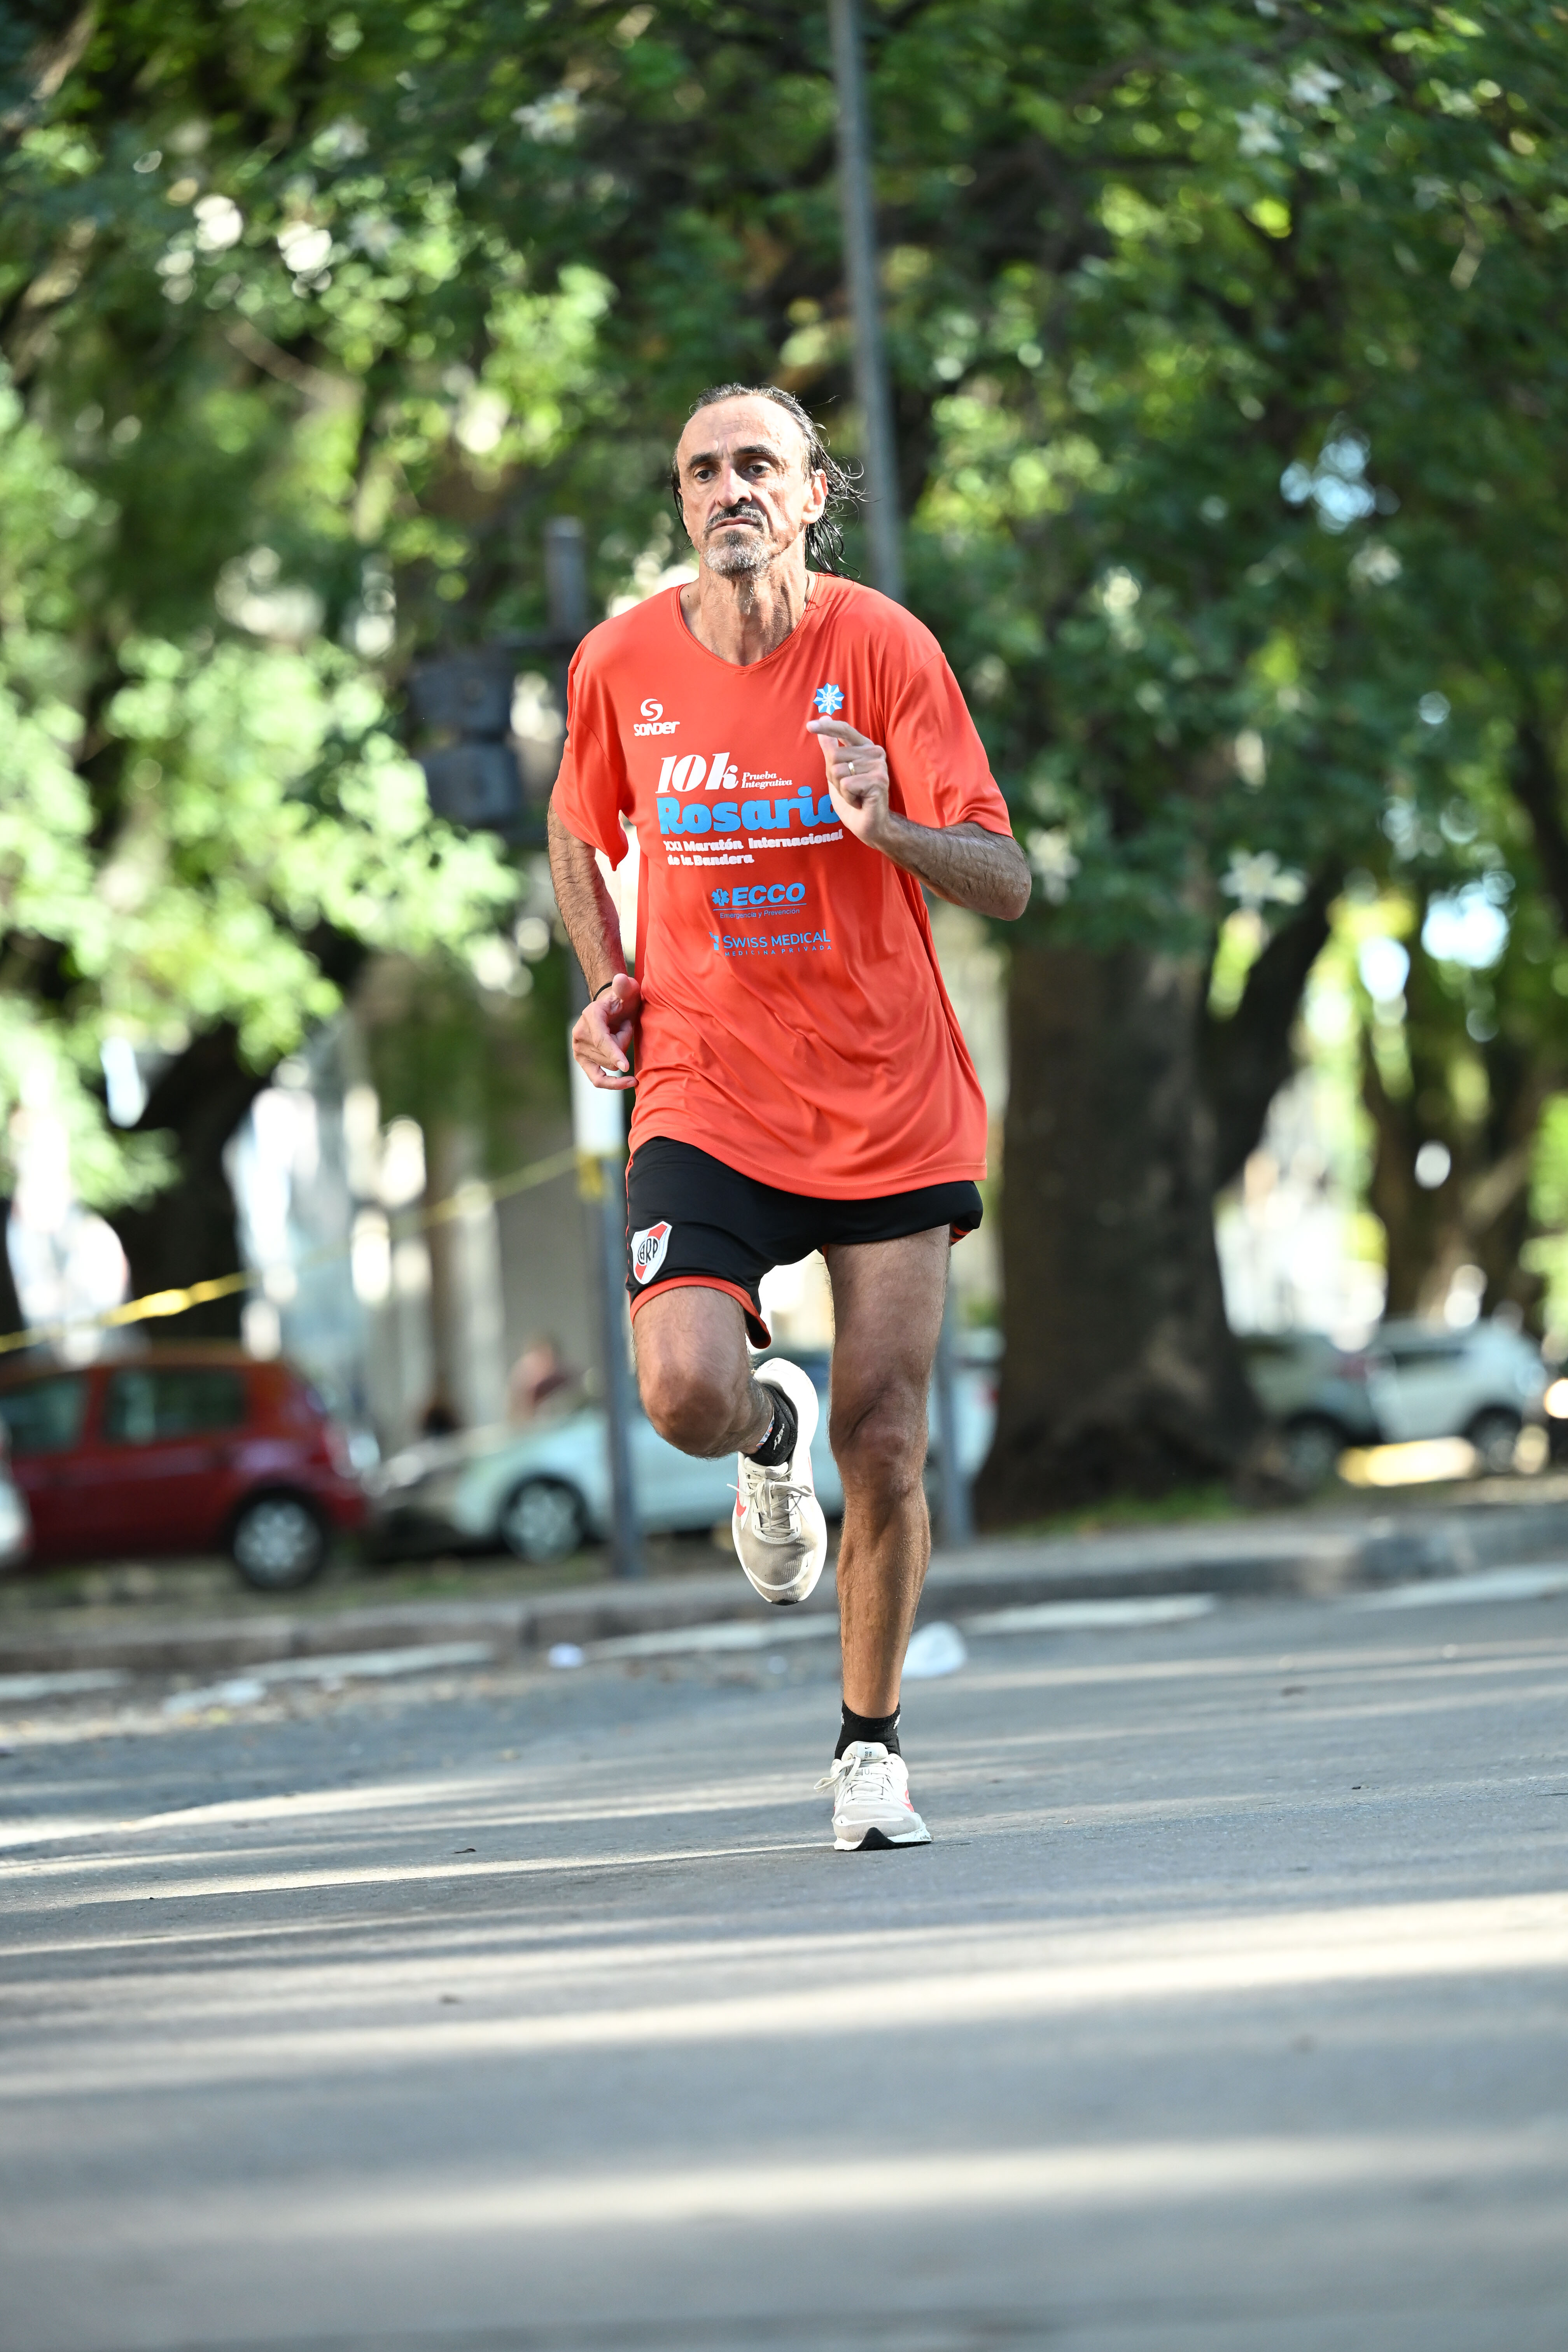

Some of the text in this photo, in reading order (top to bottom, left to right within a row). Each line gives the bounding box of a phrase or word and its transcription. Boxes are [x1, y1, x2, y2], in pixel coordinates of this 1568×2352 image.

[655, 752, 738, 793] 10k
[742, 771, 777, 780] Prueba
[741, 778, 793, 789] Integrativa
[656, 785, 840, 835] Rosario
[663, 829, 843, 851] XXI Maratón Internacional
[667, 854, 755, 866] de la Bandera
[732, 882, 805, 906] ECCO
[764, 908, 800, 917] Prevención
[771, 929, 831, 947] MEDICAL
[781, 945, 832, 954] PRIVADA
